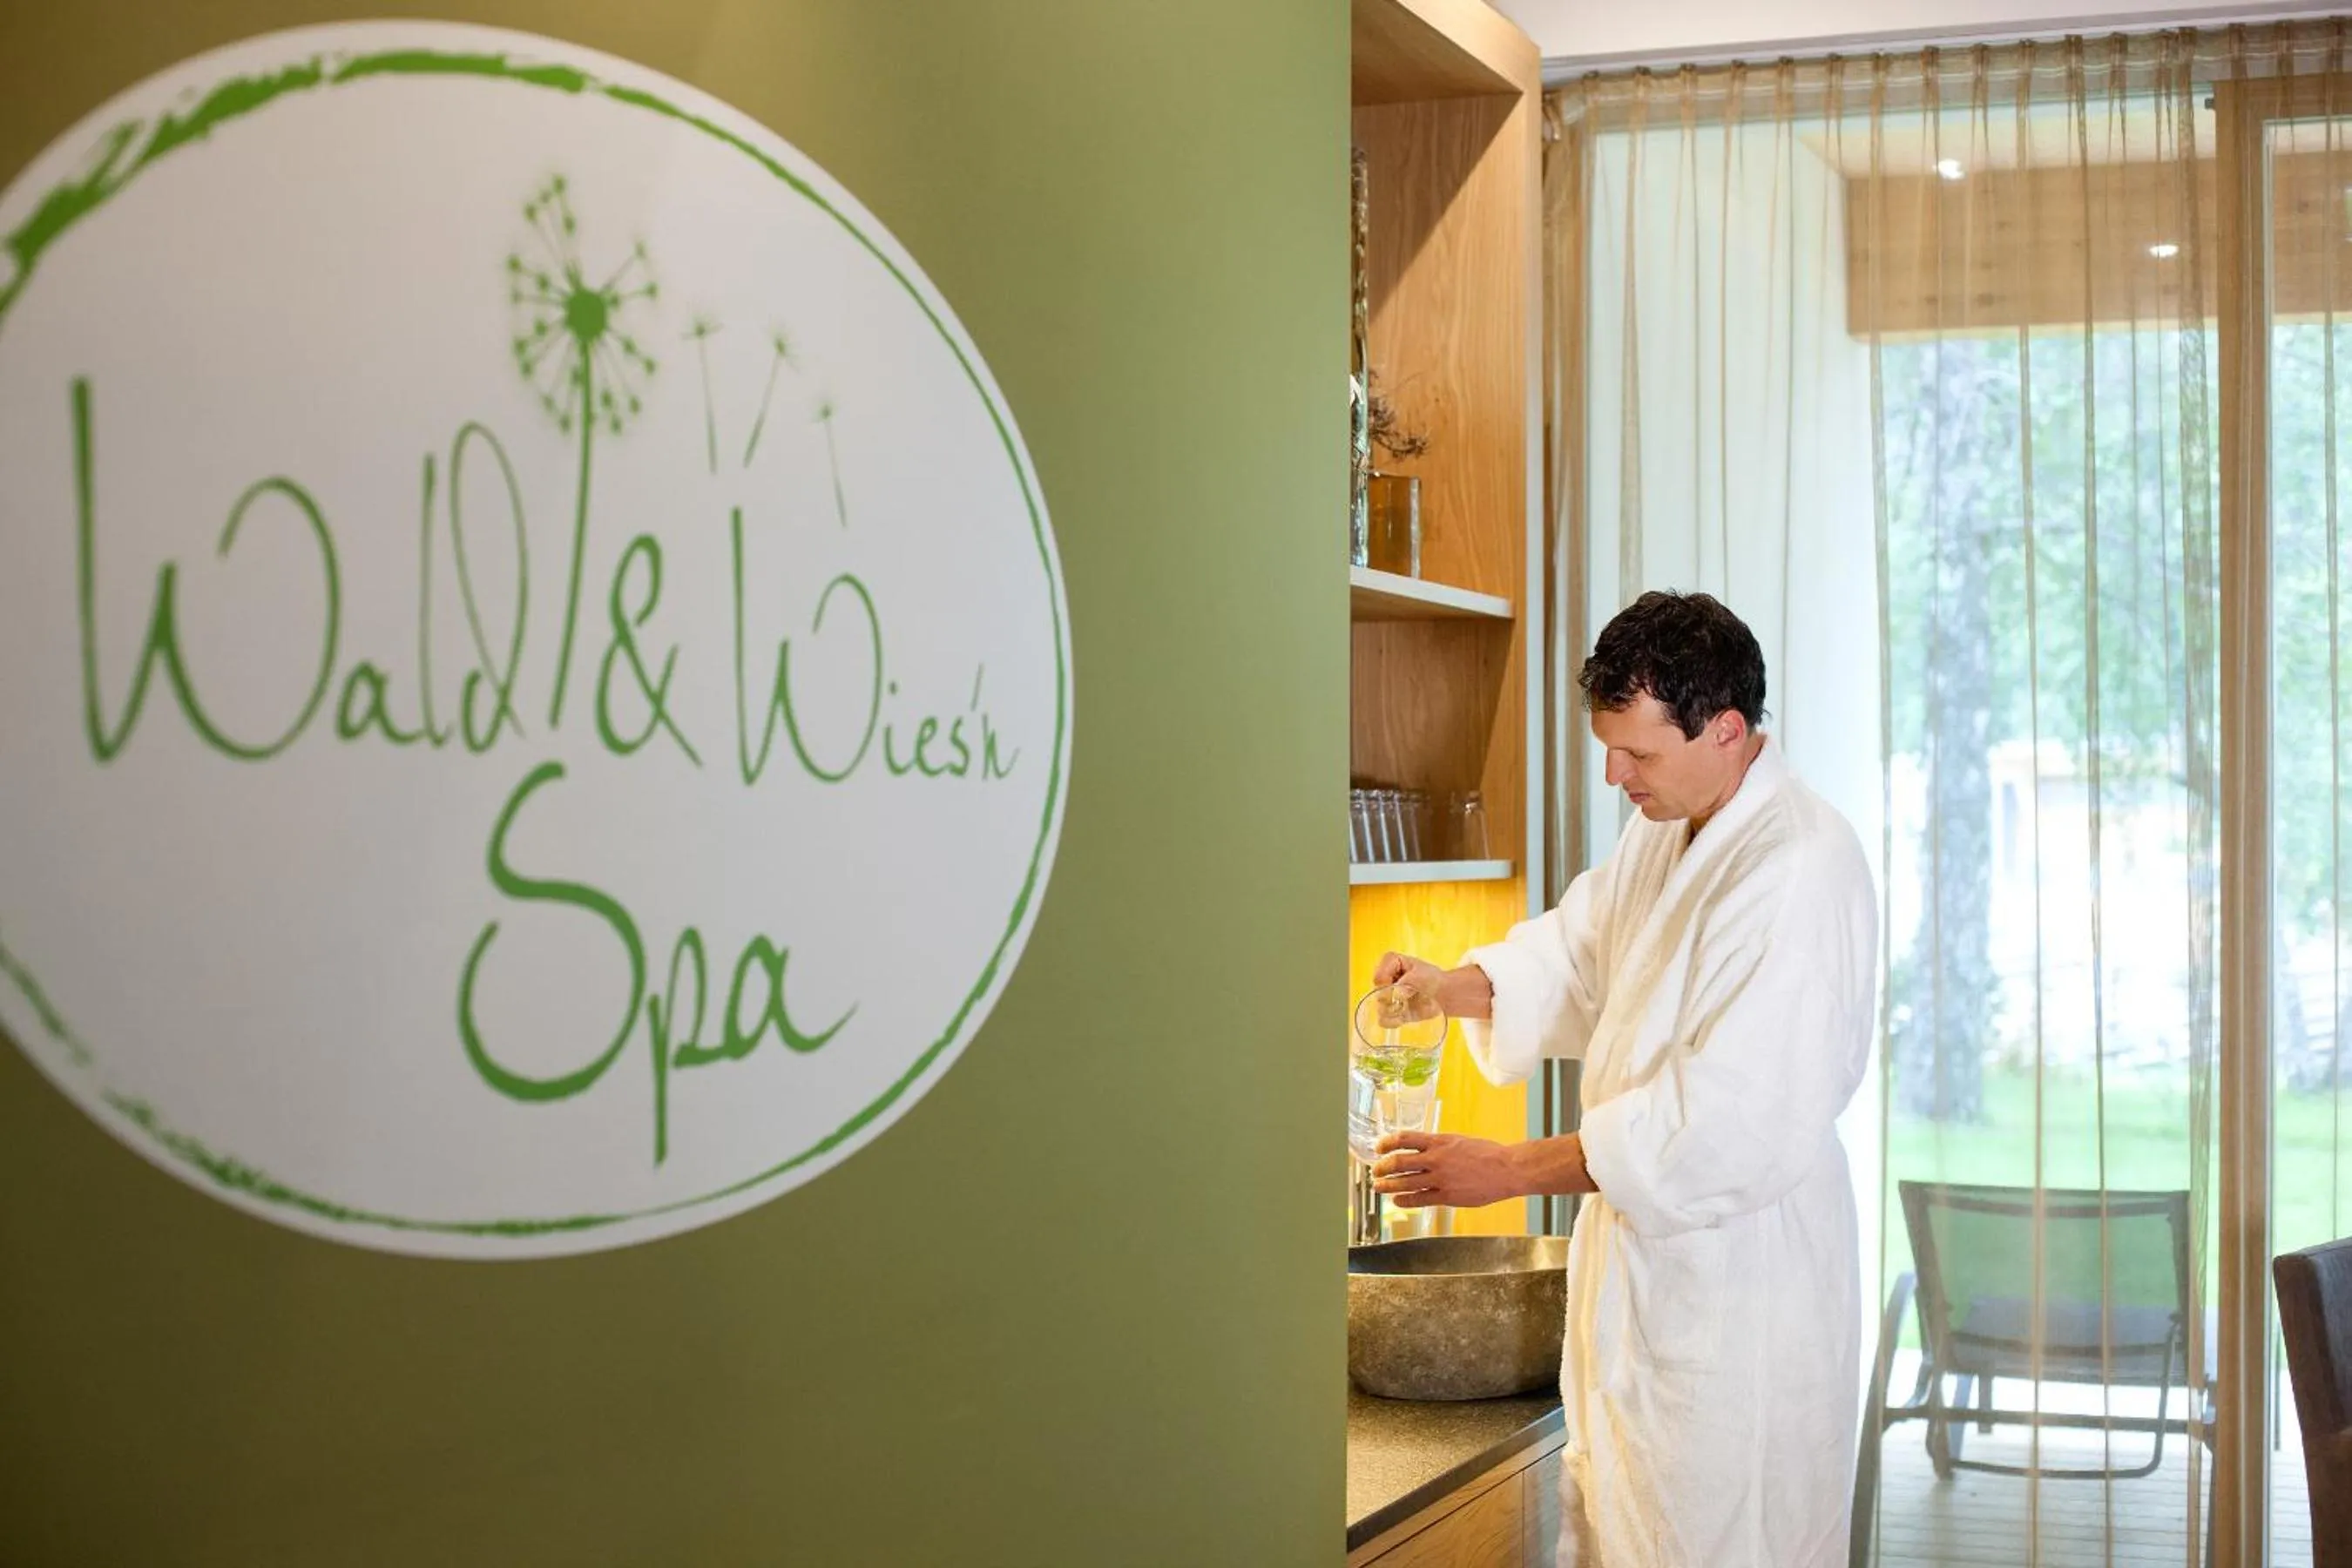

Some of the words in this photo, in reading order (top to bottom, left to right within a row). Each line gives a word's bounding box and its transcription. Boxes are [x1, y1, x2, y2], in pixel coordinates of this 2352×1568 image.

[70, 375, 530, 767] Wald
[595, 533, 702, 767] &
[456, 760, 860, 1168] Spa
